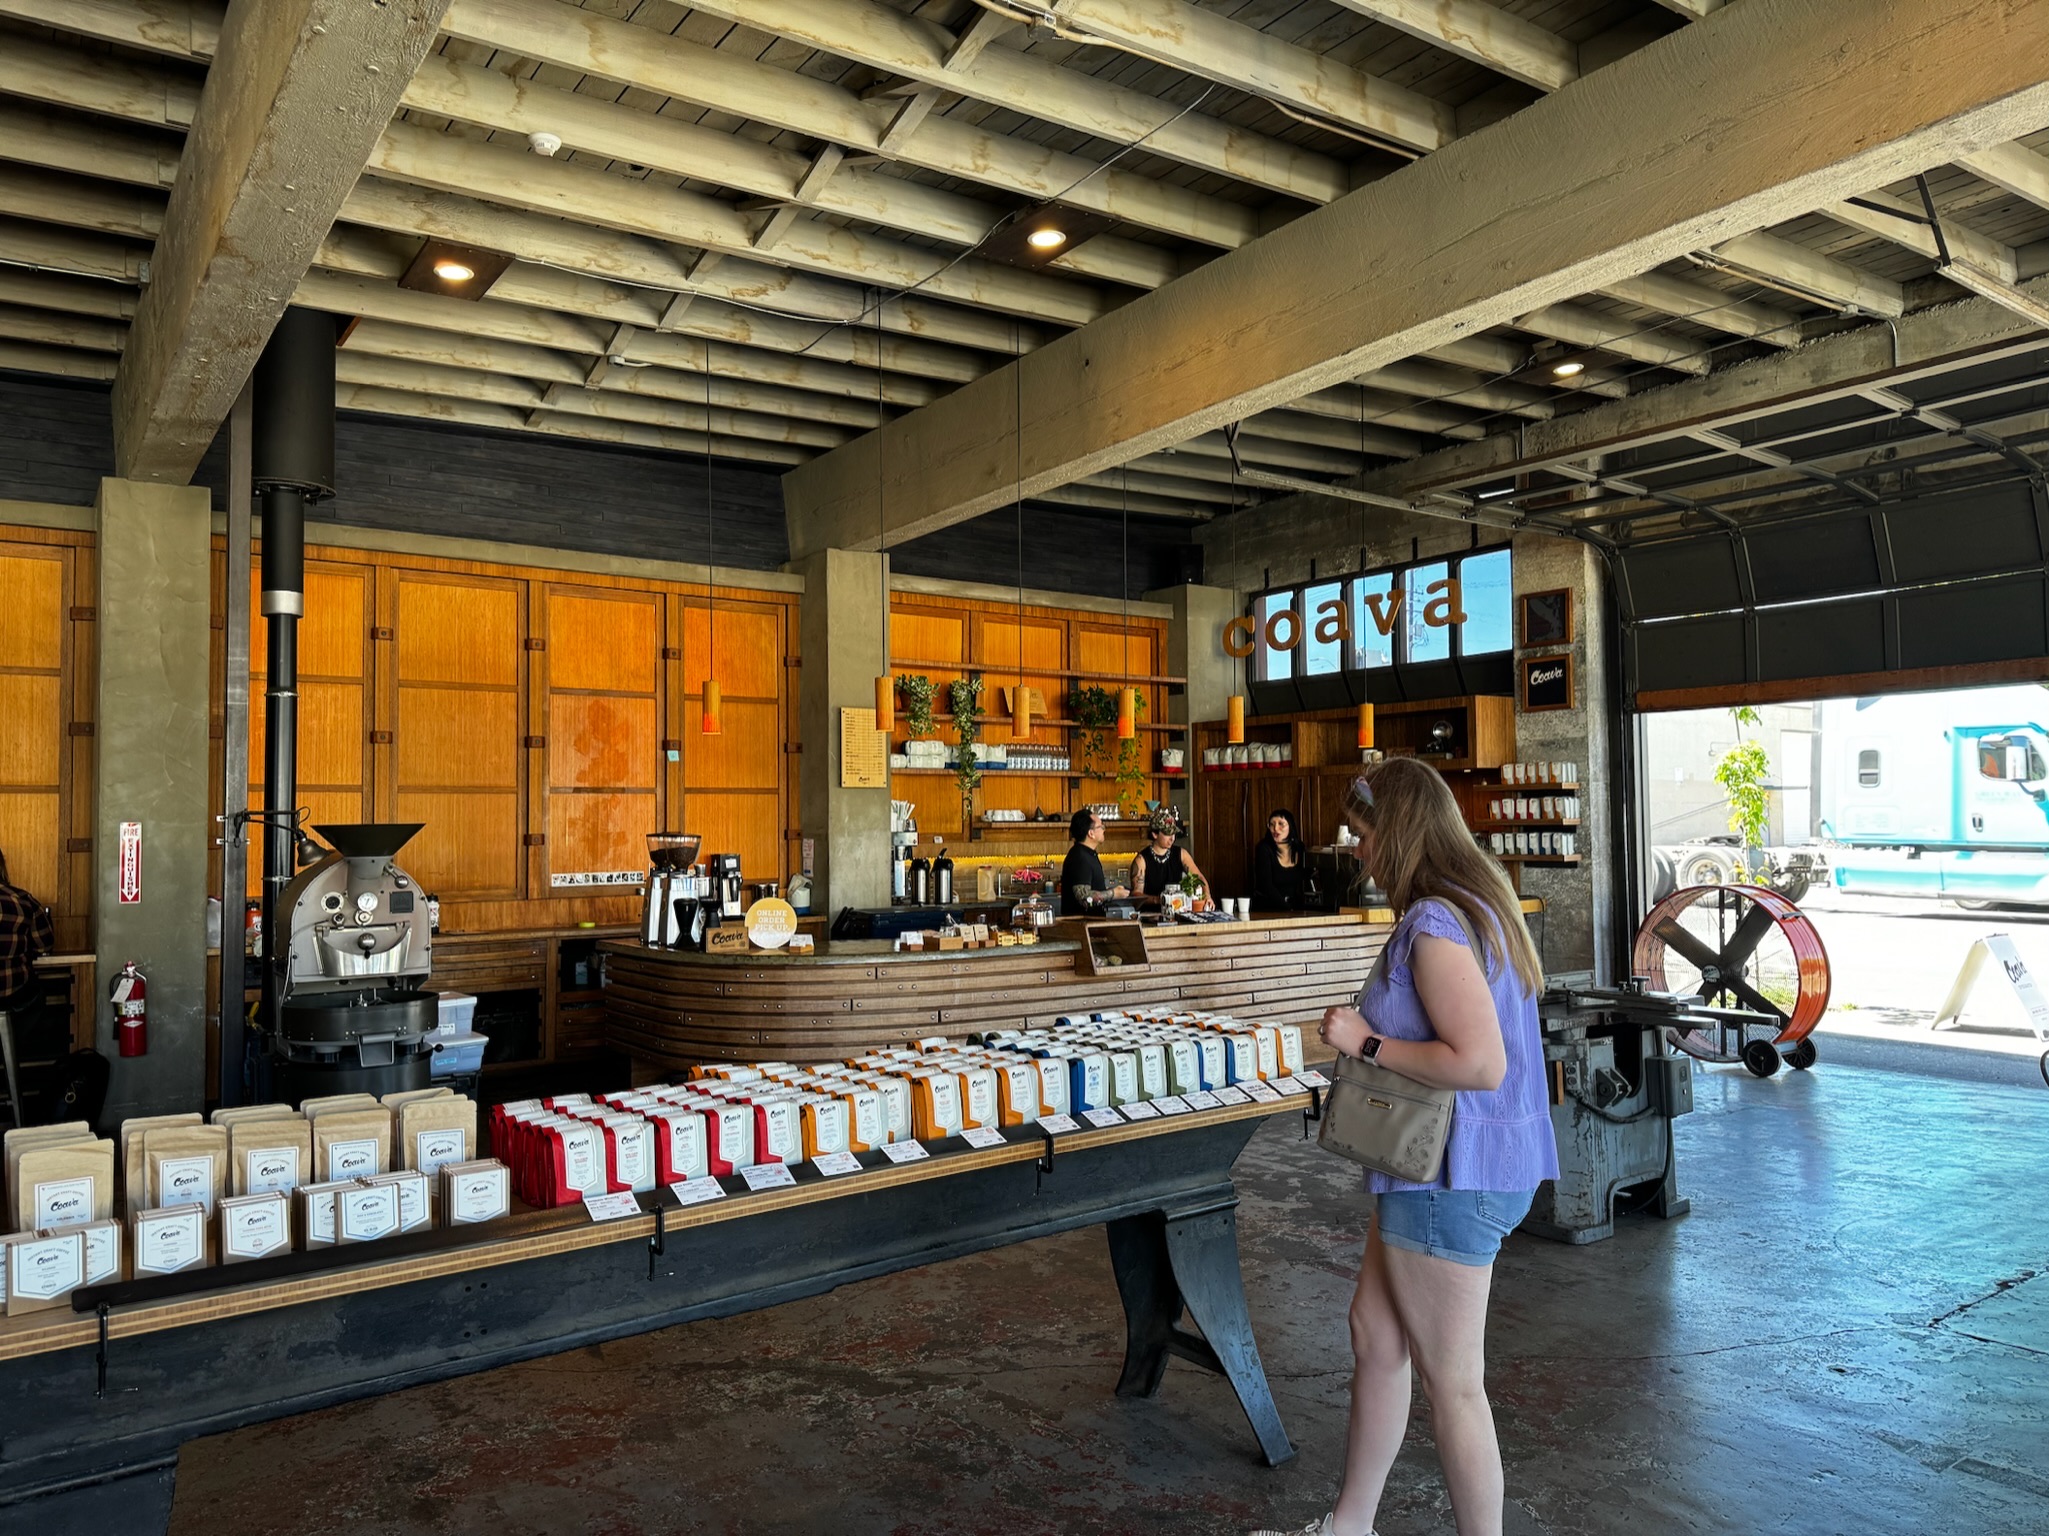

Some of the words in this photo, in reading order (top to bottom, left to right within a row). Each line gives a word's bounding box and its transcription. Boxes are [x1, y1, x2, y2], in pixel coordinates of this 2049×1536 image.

[1222, 578, 1467, 658] coava
[1530, 667, 1563, 686] Coava
[123, 828, 139, 836] FIRE
[756, 909, 788, 917] ONLINE
[755, 923, 775, 931] PICK
[711, 929, 744, 945] Coava
[2003, 955, 2028, 984] Coava
[724, 1114, 741, 1124] Coava
[675, 1123, 694, 1135] Coava
[568, 1138, 590, 1150] Coava
[621, 1133, 641, 1145] Coava
[430, 1145, 453, 1157] Coava
[342, 1157, 366, 1169] Coava
[261, 1165, 285, 1177] Coava
[173, 1175, 199, 1188] Coava
[471, 1185, 489, 1194] Coava
[50, 1198, 79, 1212] Coava
[361, 1201, 379, 1211] Coava
[247, 1215, 267, 1226] Coava
[160, 1229, 181, 1240] Coava
[37, 1254, 59, 1265] Coava
